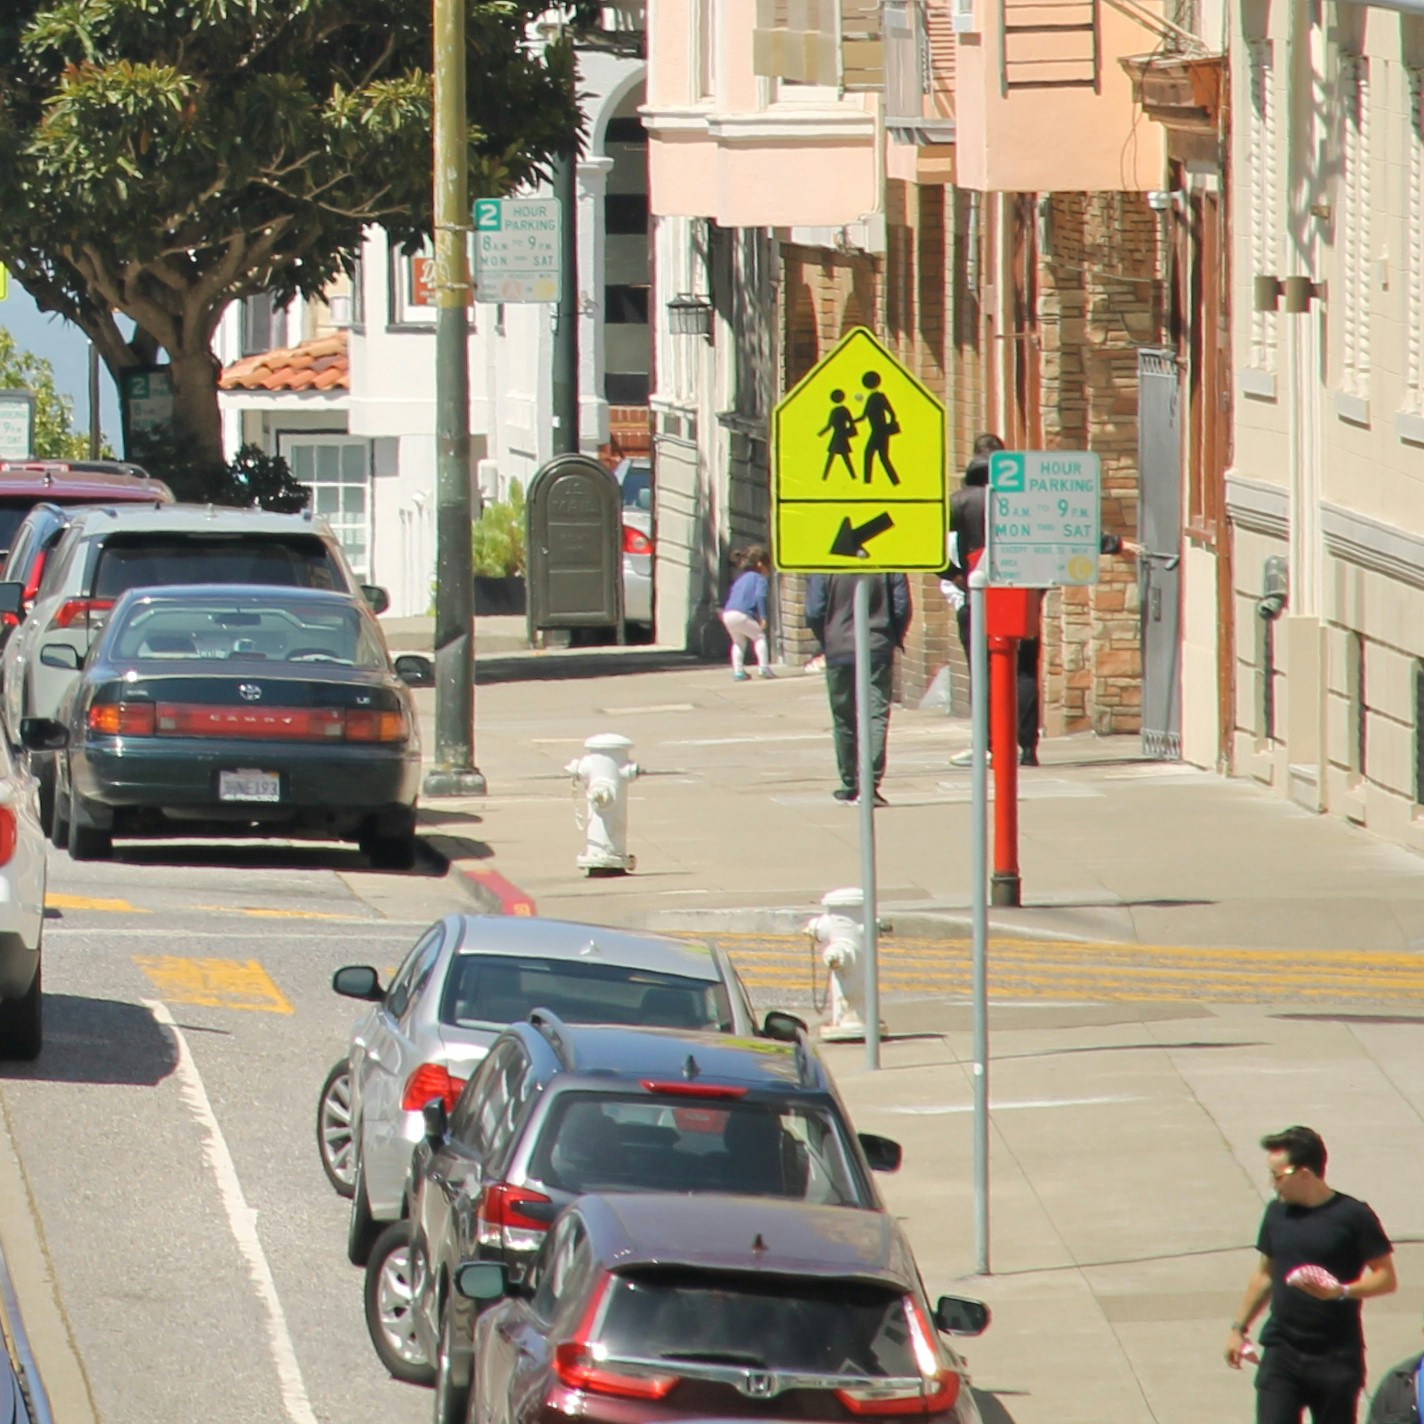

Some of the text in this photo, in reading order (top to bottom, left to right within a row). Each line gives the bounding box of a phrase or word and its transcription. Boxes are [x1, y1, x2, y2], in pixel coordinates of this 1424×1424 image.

[479, 204, 498, 226] 2
[513, 206, 547, 217] HOUR
[504, 219, 556, 231] PARKING
[482, 235, 492, 251] 8
[528, 235, 536, 250] 9
[480, 256, 508, 266] MON
[533, 256, 554, 266] SAT
[132, 377, 146, 394] 2
[997, 460, 1019, 487] 2
[1040, 462, 1081, 474] HOUR
[1029, 479, 1094, 492] PARKING
[999, 497, 1009, 516] 8
[1058, 499, 1068, 517] 9
[995, 524, 1030, 536] MON
[1063, 524, 1091, 537] SAT
